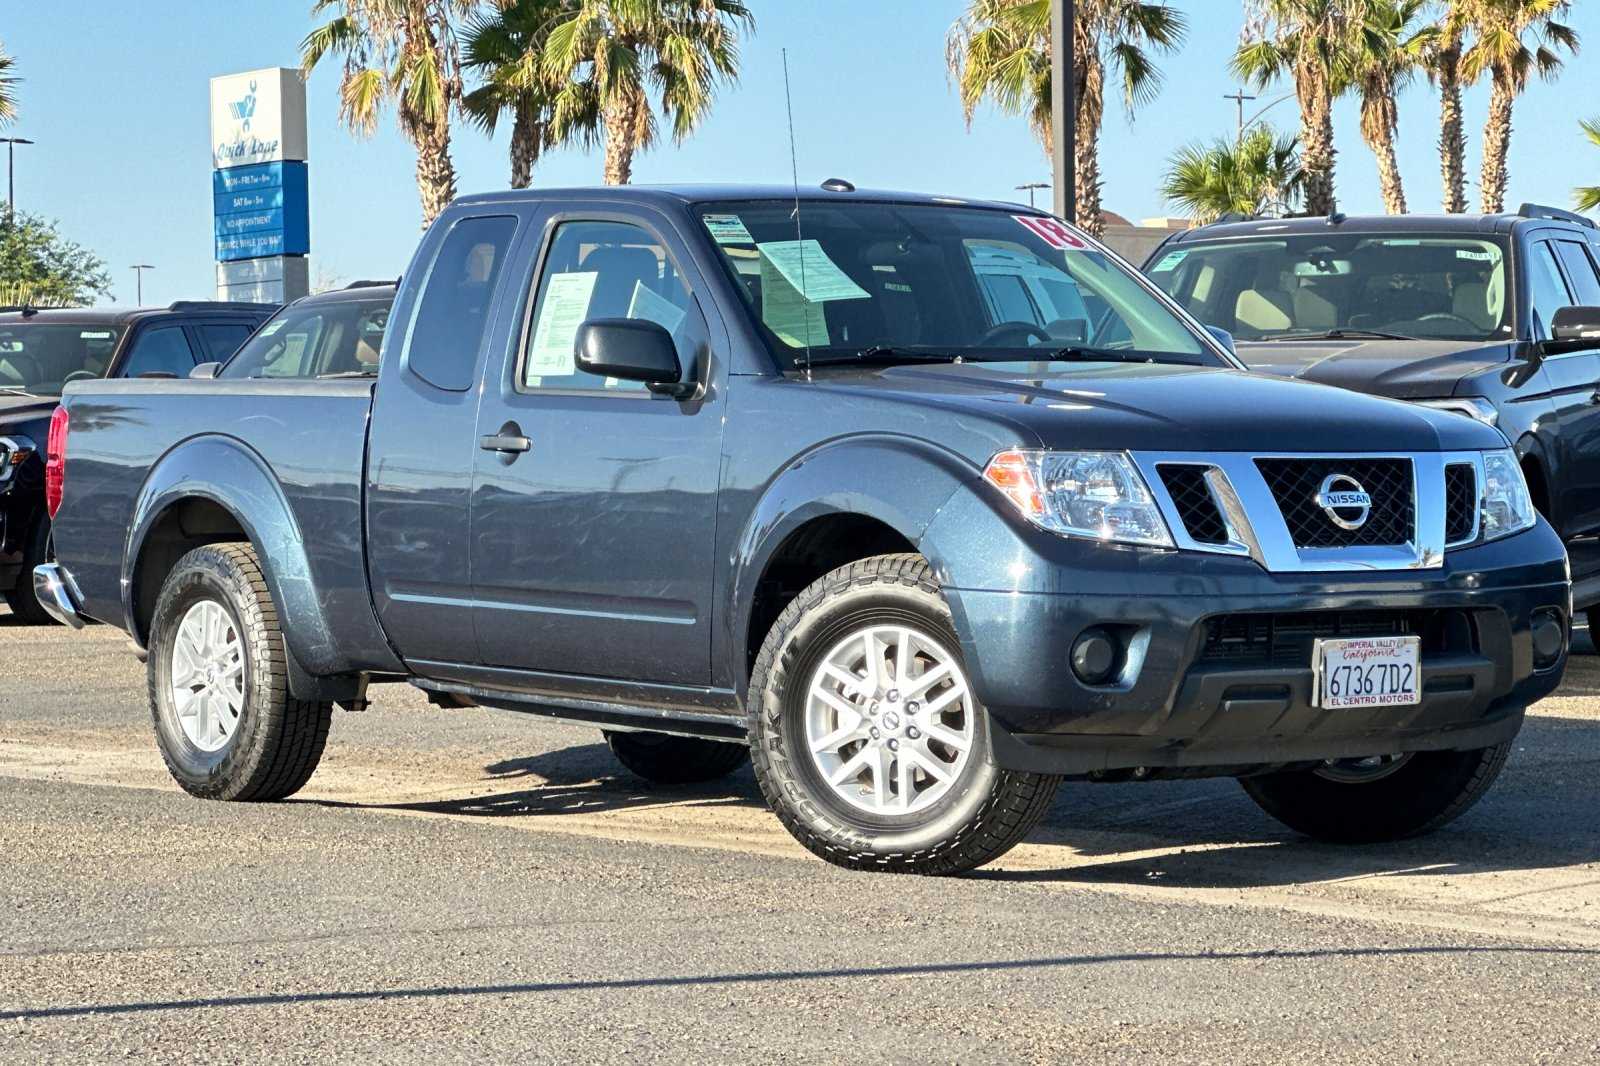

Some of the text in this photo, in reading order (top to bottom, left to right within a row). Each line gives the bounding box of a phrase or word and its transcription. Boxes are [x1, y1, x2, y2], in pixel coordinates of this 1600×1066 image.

[217, 140, 246, 160] Quick
[233, 197, 243, 208] SAT
[235, 215, 272, 227] APPOINTMENT
[1017, 216, 1085, 248] 18
[217, 239, 240, 249] VICE
[1327, 494, 1370, 504] NISSAN
[1347, 639, 1397, 649] IMPERIAL VALLEY
[1343, 649, 1400, 663] California
[1330, 664, 1413, 696] 67367D2
[1331, 694, 1414, 706] EL CENTRO MOTORS
